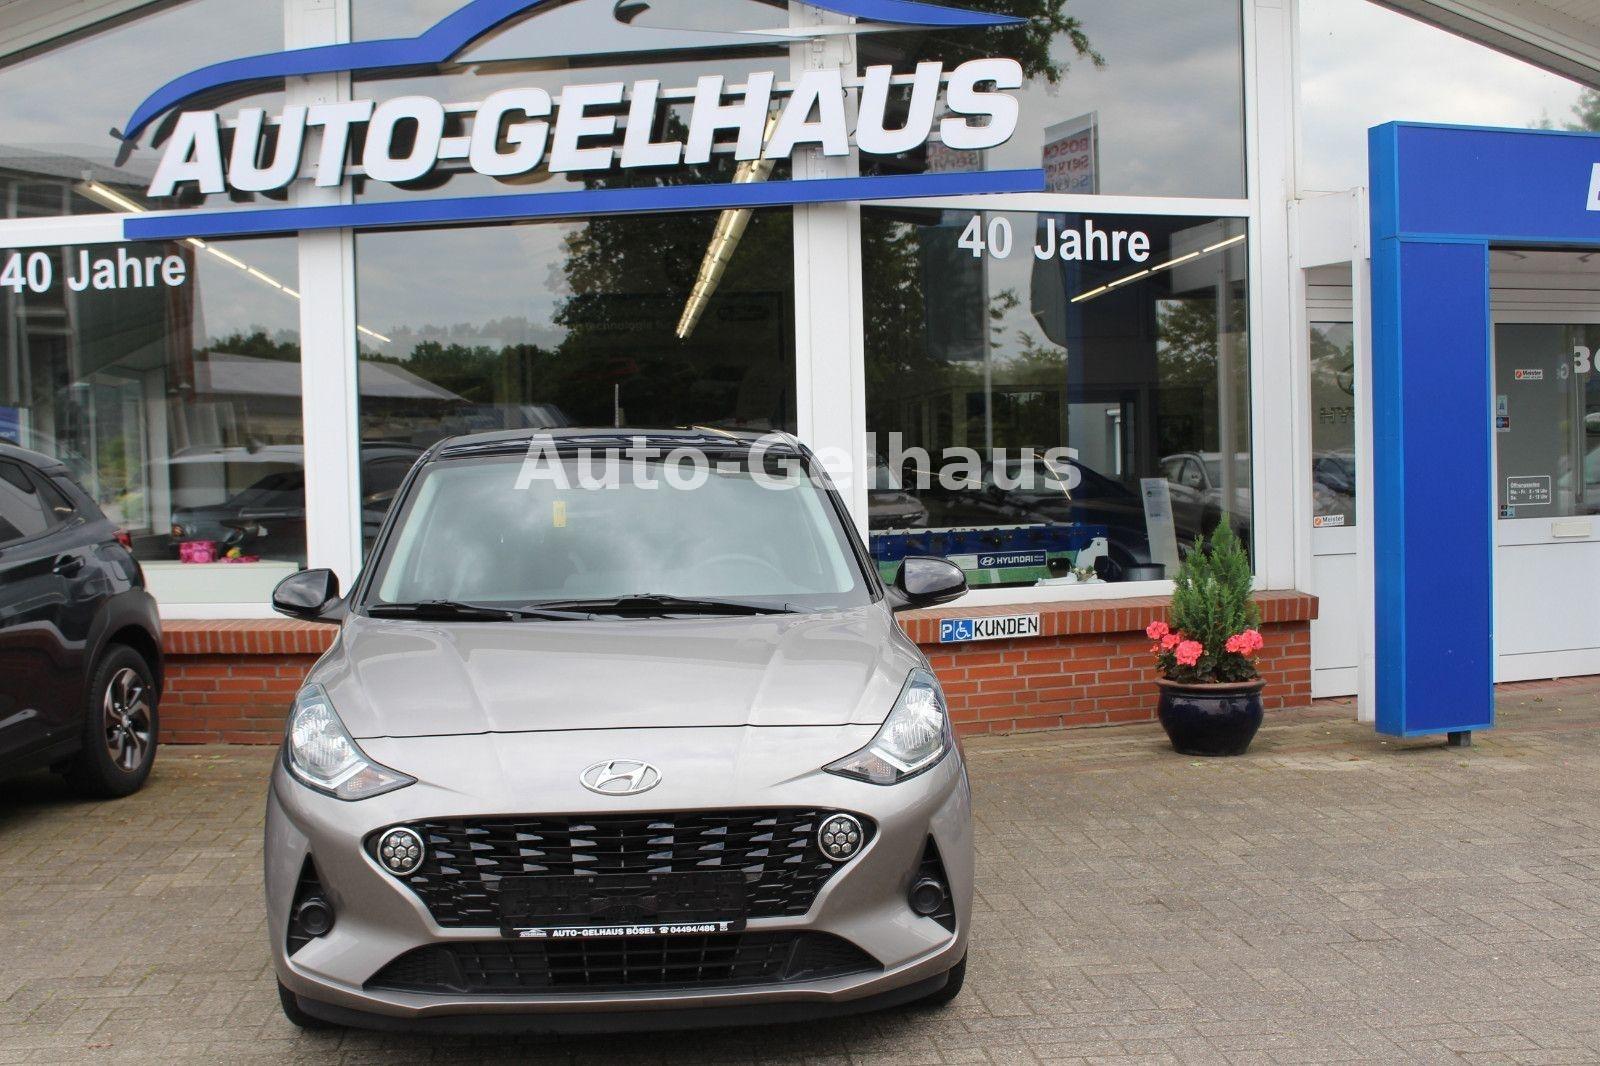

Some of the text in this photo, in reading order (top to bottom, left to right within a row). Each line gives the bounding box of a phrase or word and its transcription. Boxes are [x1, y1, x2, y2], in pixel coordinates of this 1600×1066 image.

[147, 58, 1023, 197] AUTO-GELHAUS
[958, 216, 1151, 262] 40 Jahre
[0, 248, 187, 294] 40 Jahre
[996, 555, 1033, 564] HYUNDAI
[974, 617, 1038, 637] KUNDEN
[552, 926, 624, 937] AUTO-GELHAUS
[626, 926, 655, 935] BÖSEL
